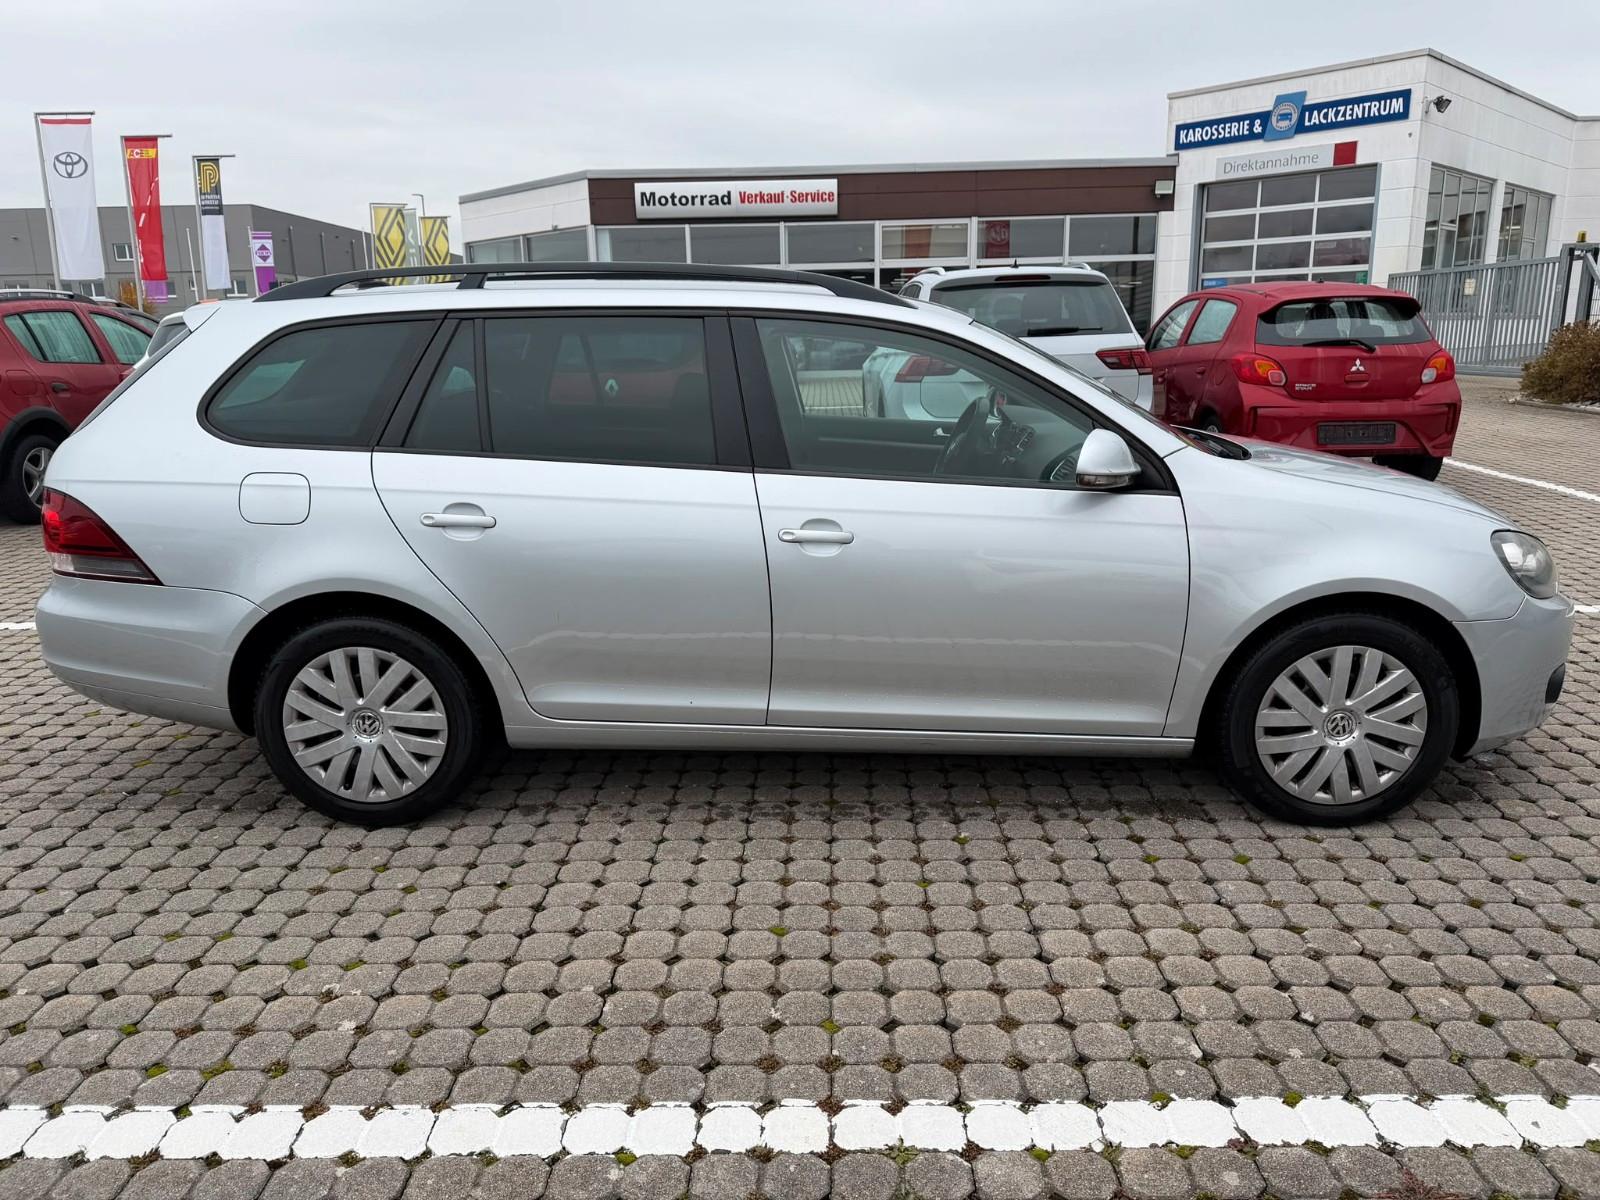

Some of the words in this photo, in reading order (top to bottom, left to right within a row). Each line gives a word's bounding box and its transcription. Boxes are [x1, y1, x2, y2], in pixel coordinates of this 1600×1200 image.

[1179, 120, 1250, 144] KAROSSERIE
[1253, 119, 1263, 134] &
[1304, 97, 1404, 127] LACKZENTRUM
[1223, 153, 1319, 174] Direktannahme
[640, 190, 732, 207] Motorrad
[739, 191, 785, 204] Verkauf
[790, 189, 835, 203] Service
